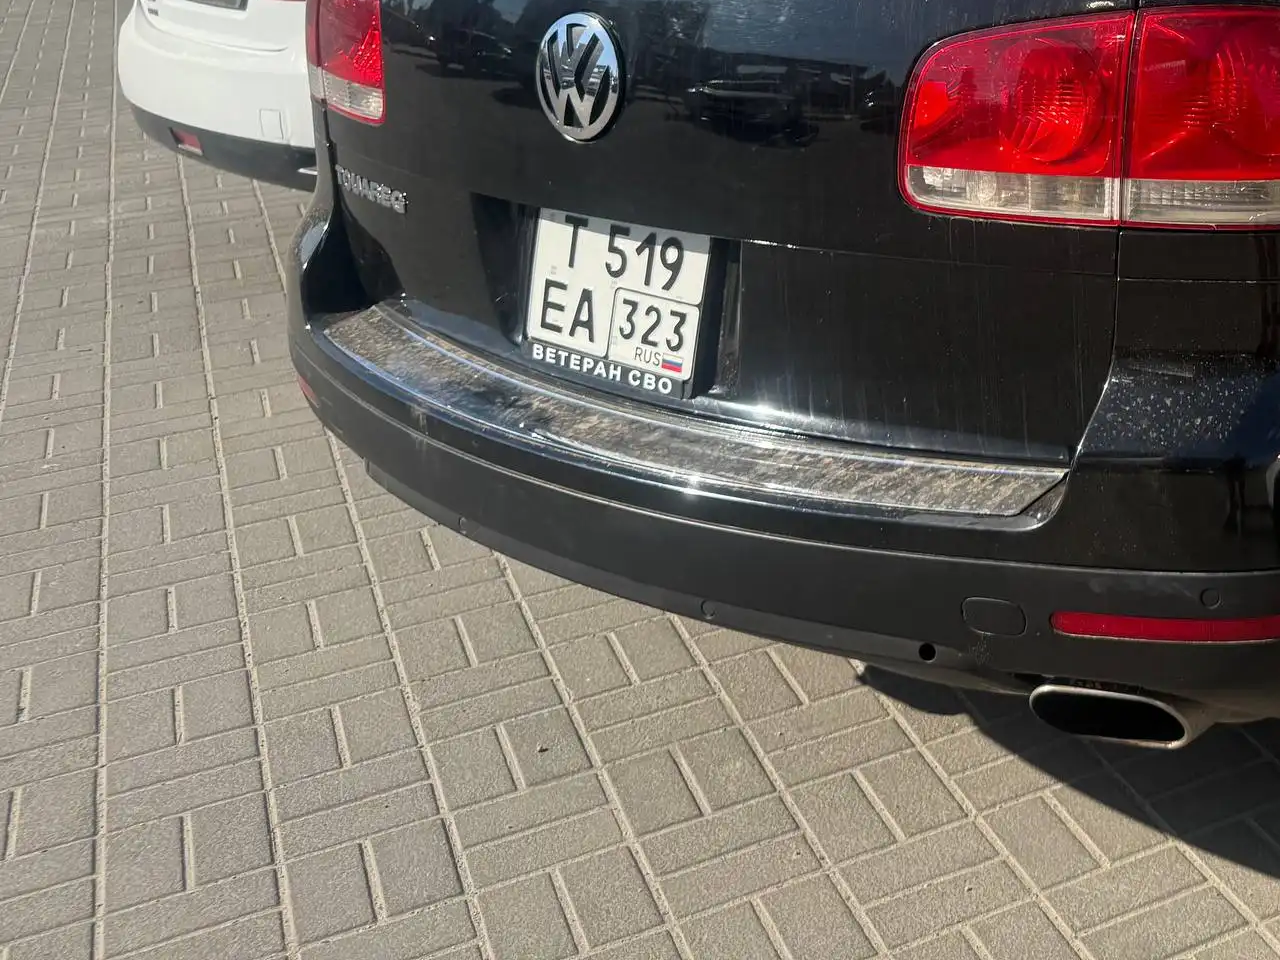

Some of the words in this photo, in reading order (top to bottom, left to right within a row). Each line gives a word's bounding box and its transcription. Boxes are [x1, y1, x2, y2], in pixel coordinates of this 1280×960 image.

[565, 214, 588, 269] Т
[605, 224, 684, 291] 519
[540, 278, 595, 343] ЕА
[619, 298, 687, 352] 323
[532, 343, 622, 382] ВЕТЕРАН
[628, 371, 672, 395] СВО
[634, 347, 662, 366] RUS
